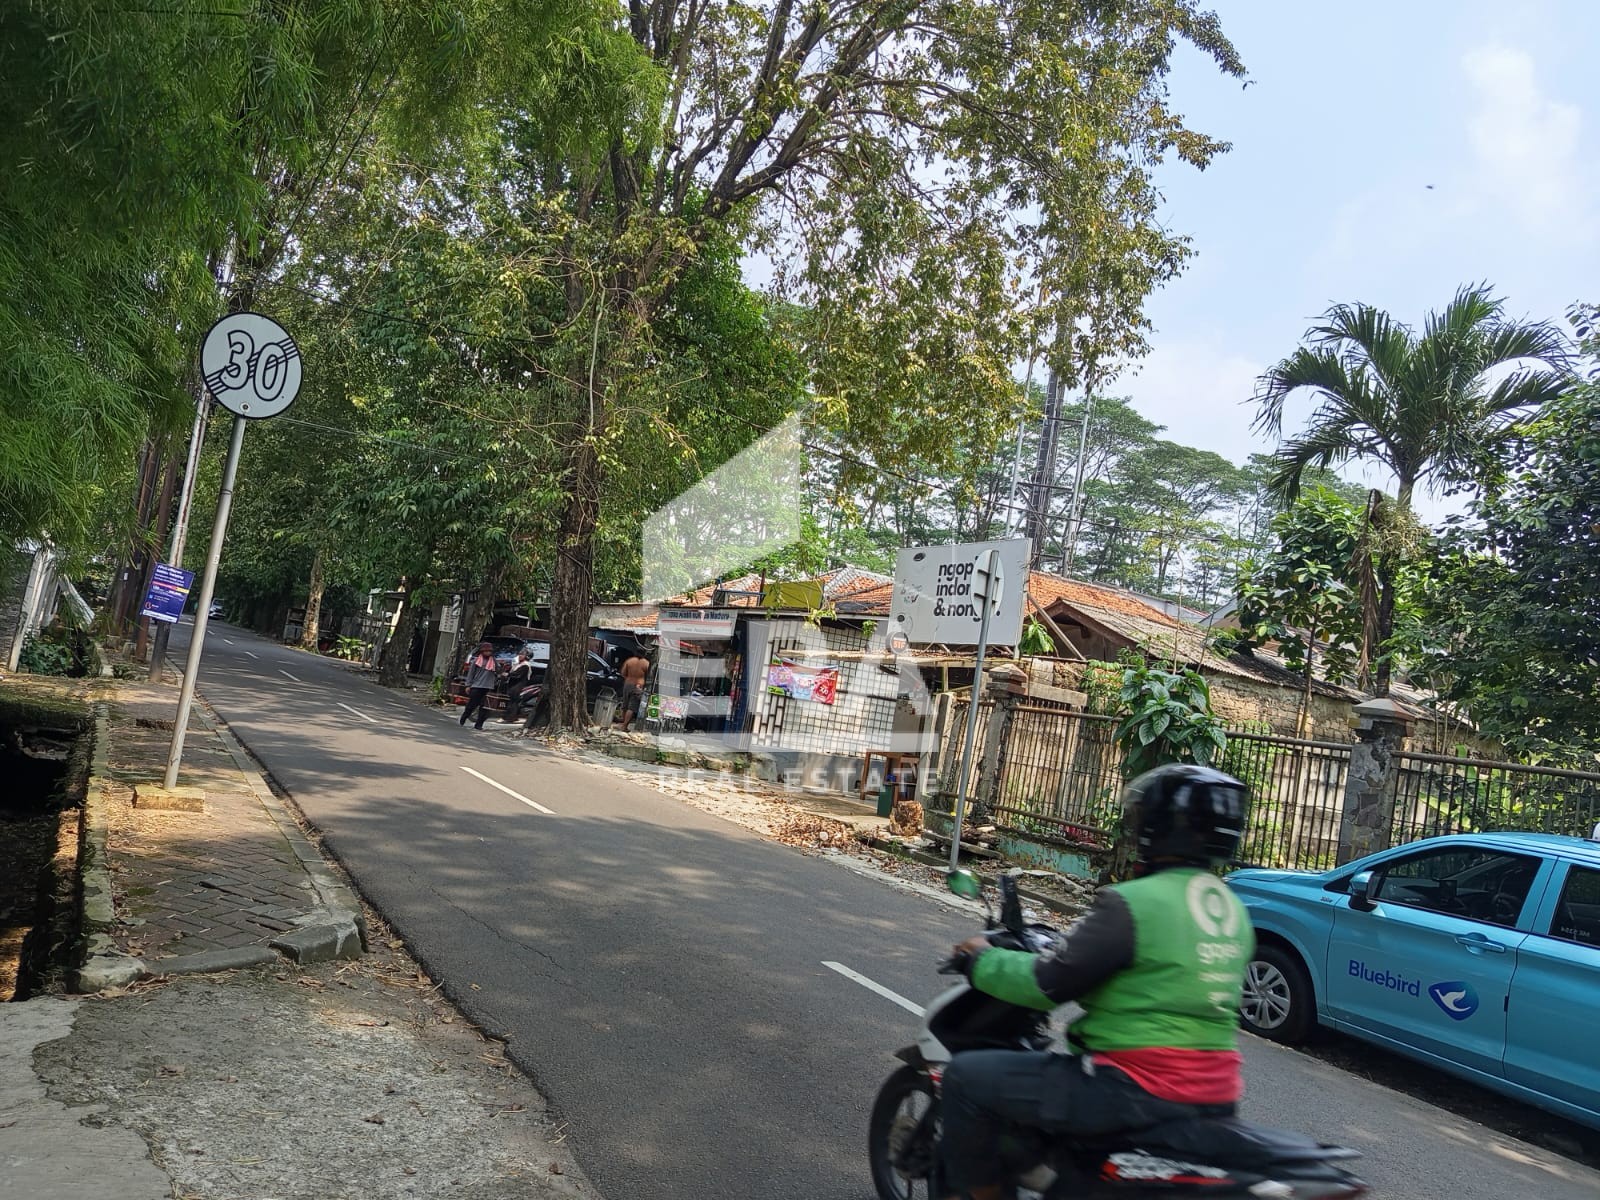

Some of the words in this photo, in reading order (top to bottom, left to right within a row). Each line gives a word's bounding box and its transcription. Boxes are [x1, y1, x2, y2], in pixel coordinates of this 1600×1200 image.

[219, 329, 289, 402] 30
[938, 555, 978, 582] ngop
[1348, 959, 1421, 997] Bluebird
